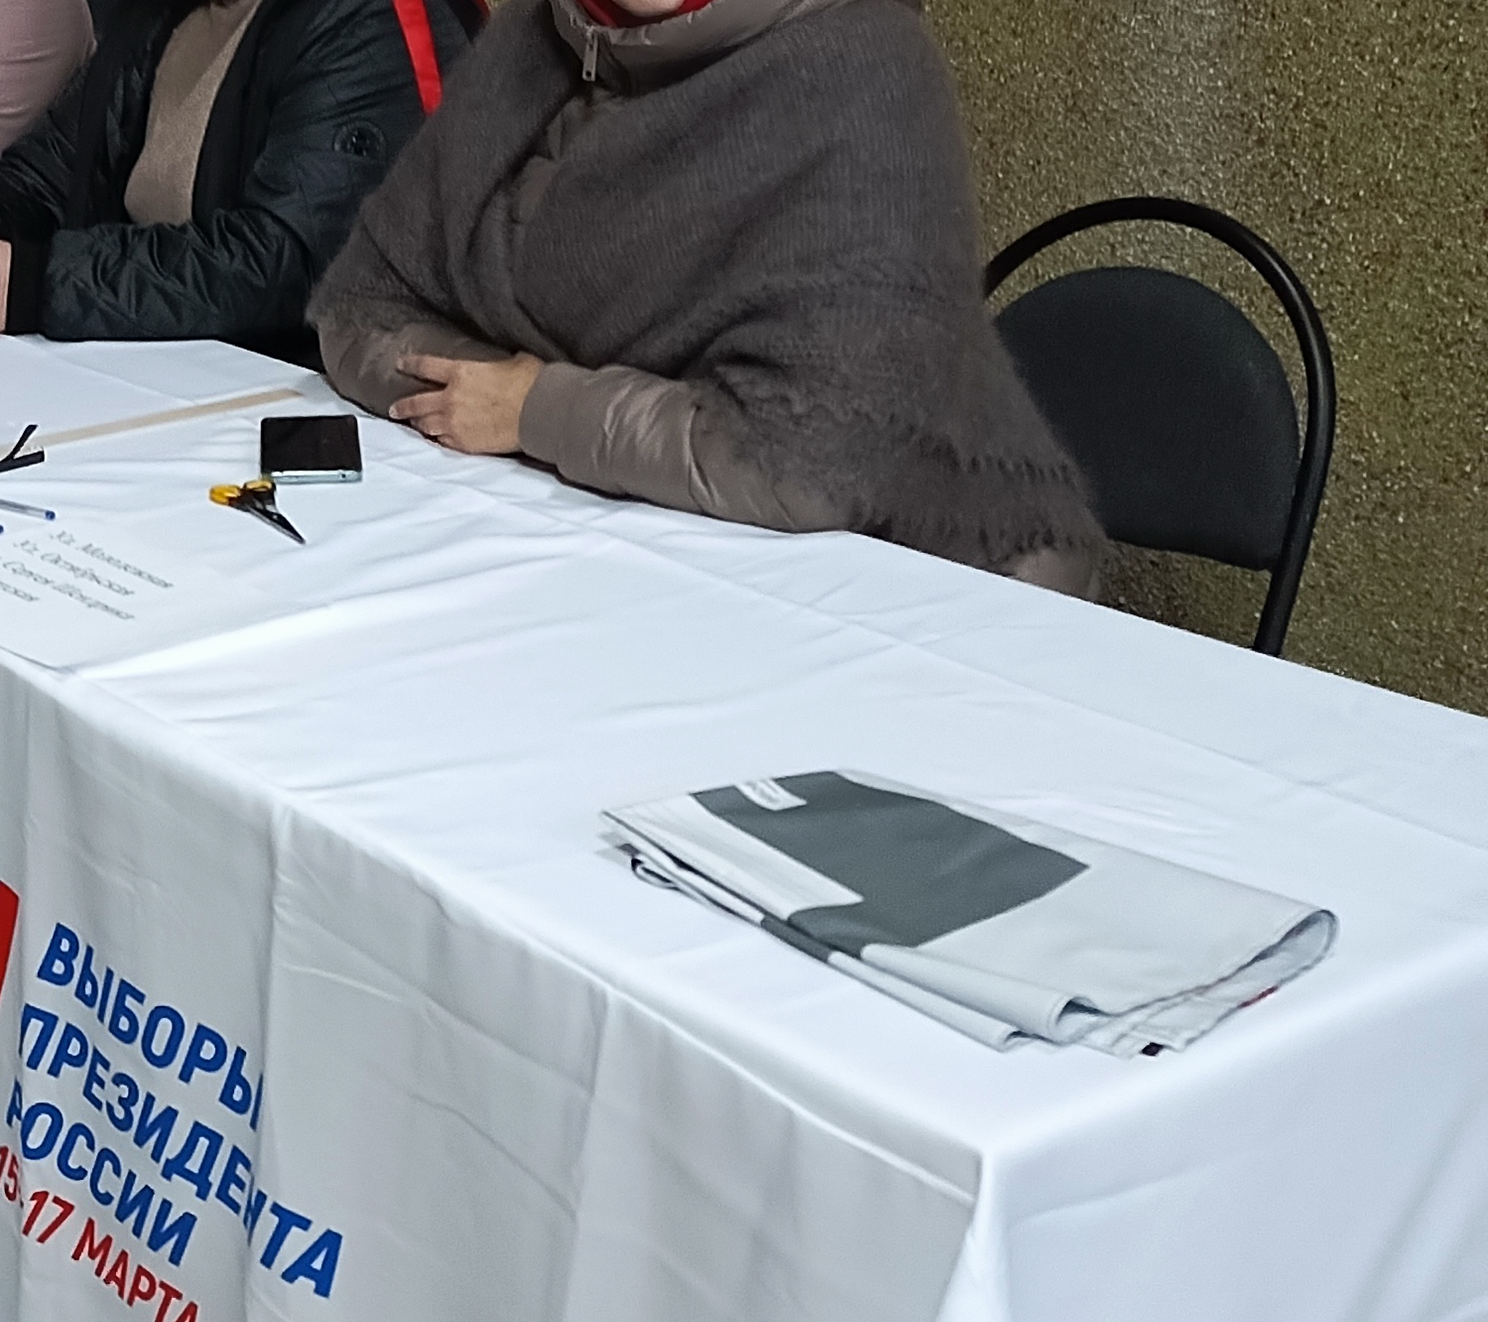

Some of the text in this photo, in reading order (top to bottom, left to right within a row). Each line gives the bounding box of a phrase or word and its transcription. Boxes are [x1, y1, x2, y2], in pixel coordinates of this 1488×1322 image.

[36, 922, 264, 1131] ВЫБОРЫ
[6, 1076, 197, 1267] РОССИИ
[19, 1003, 344, 1298] ПРЕЗИДЕНТА
